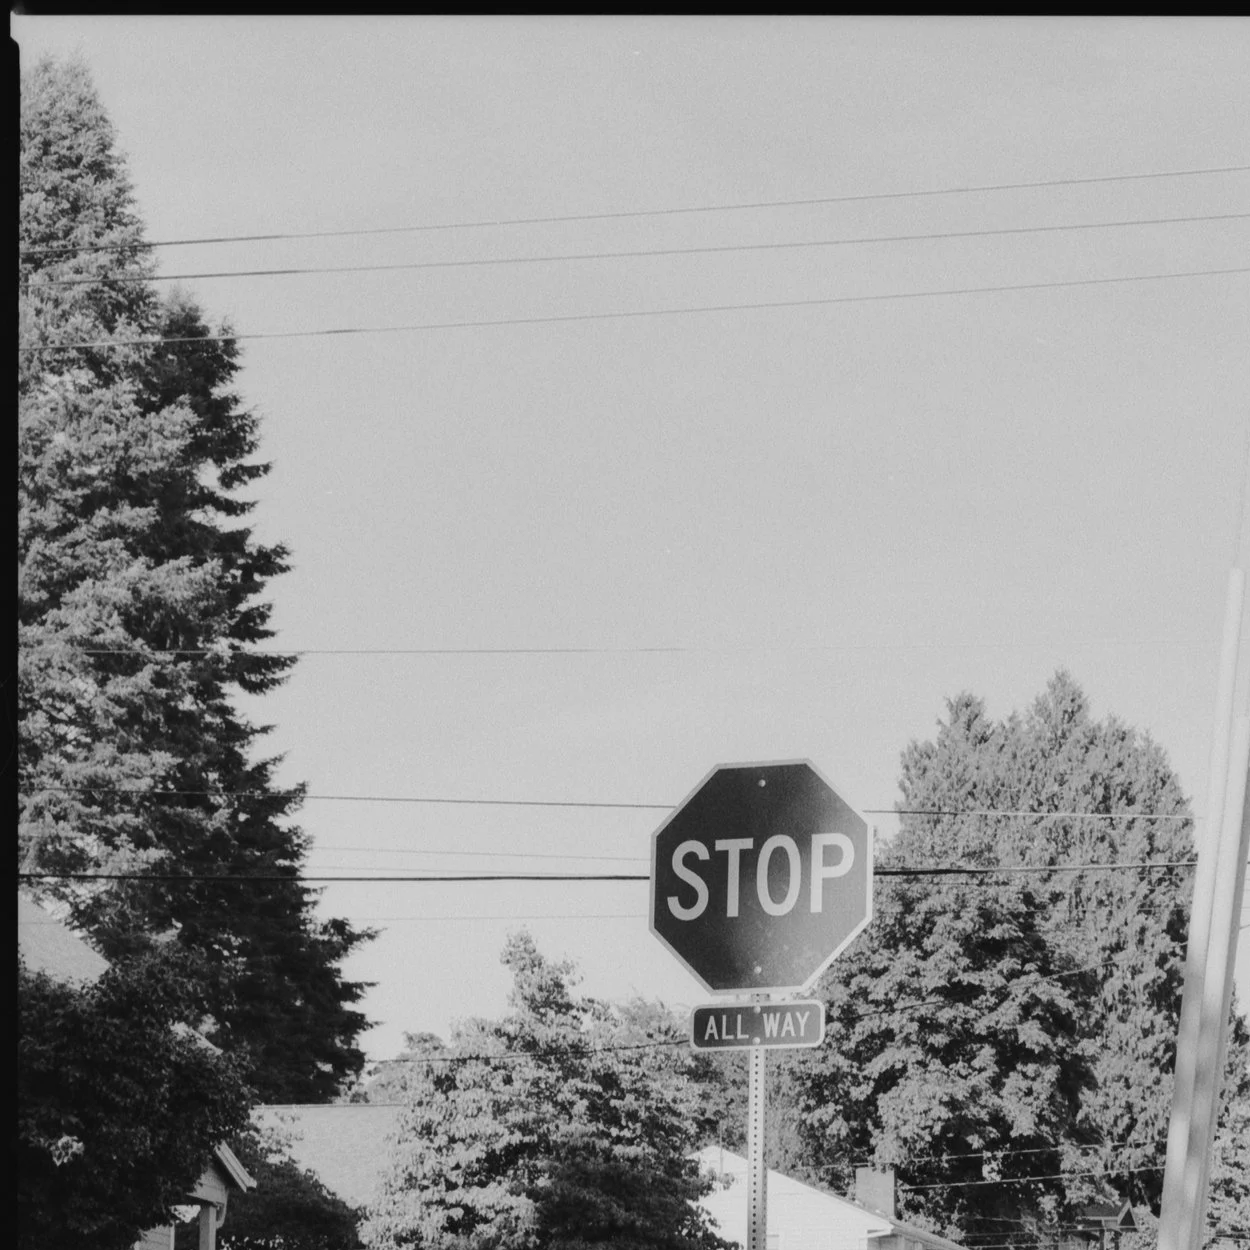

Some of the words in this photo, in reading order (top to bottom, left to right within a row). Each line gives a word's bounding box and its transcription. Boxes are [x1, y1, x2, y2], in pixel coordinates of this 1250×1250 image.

[667, 832, 855, 921] STOP
[704, 1014, 749, 1040] ALL
[762, 1011, 810, 1038] WAY
